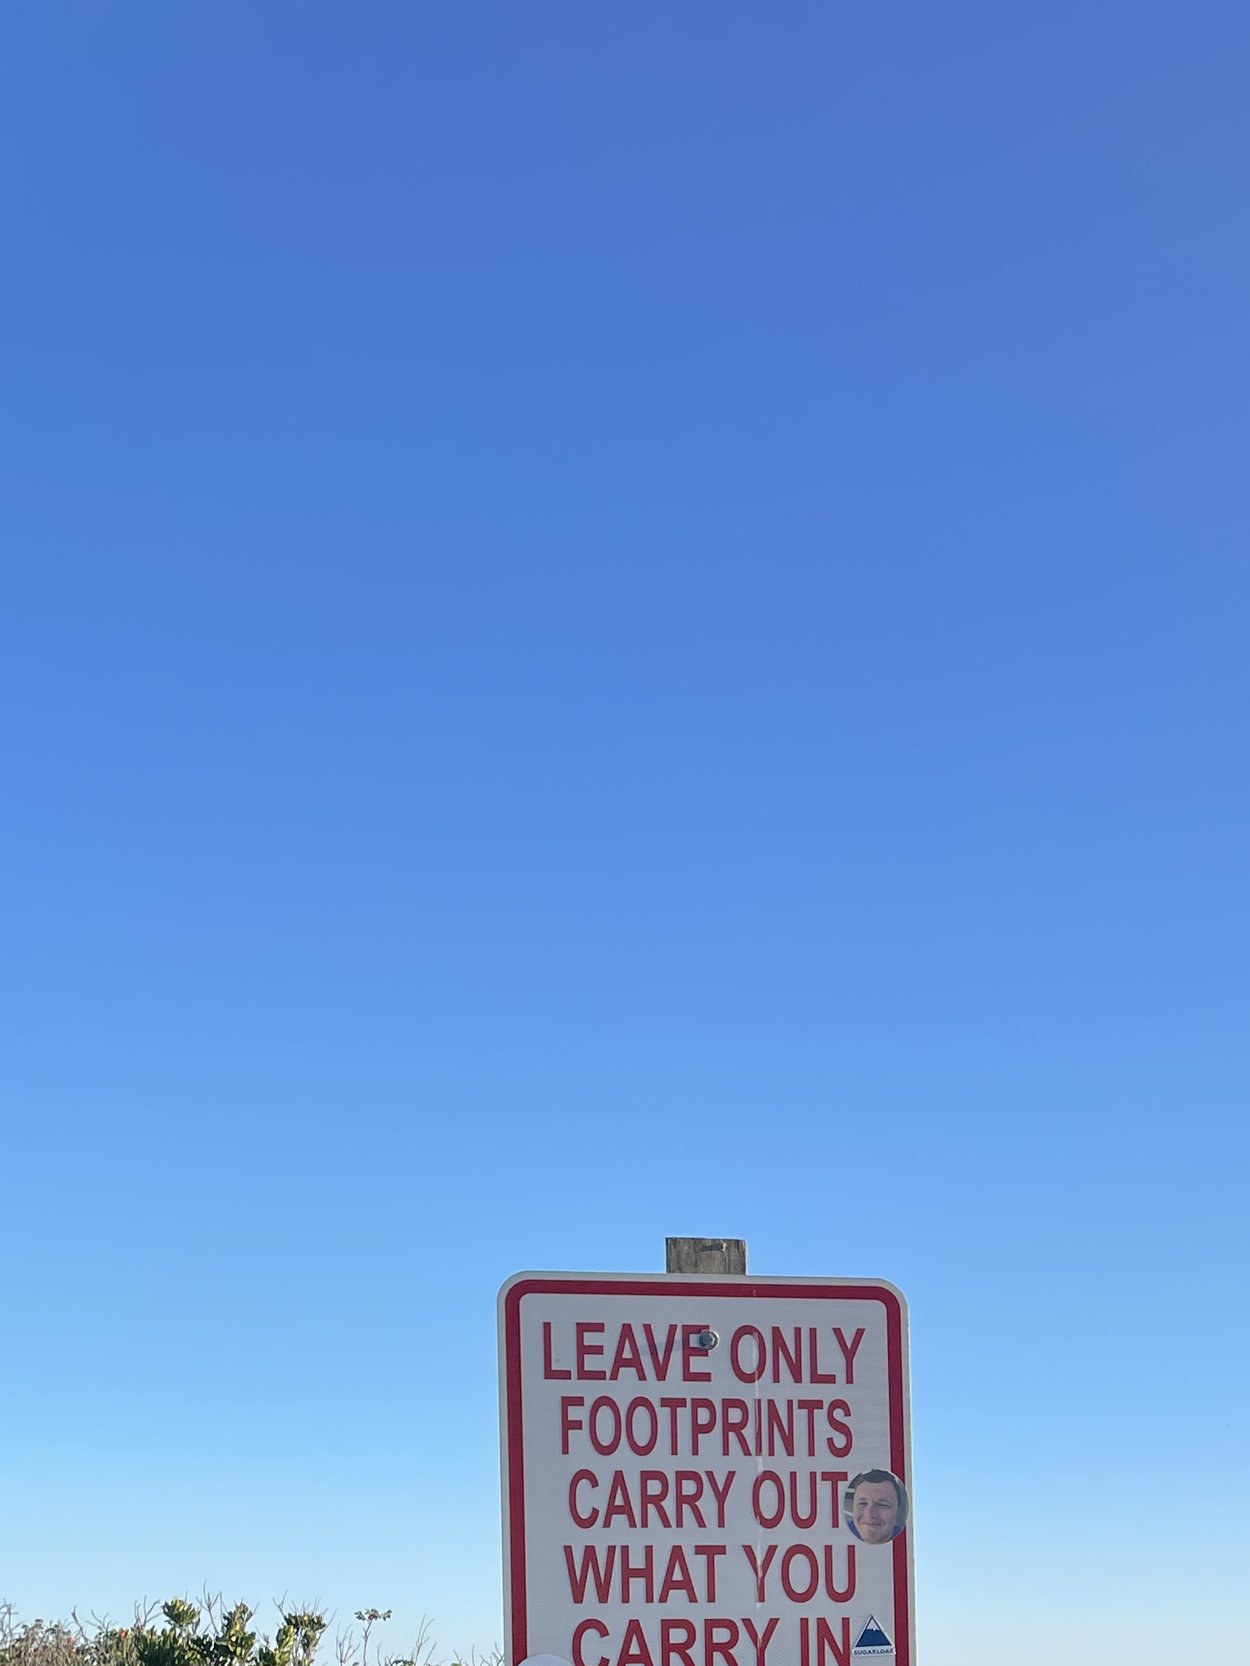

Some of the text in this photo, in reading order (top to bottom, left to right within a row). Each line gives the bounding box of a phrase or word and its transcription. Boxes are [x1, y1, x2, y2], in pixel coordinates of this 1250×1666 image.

[543, 1321, 865, 1385] LEAVE ONLY
[561, 1396, 853, 1458] FOOTPRINTS
[568, 1469, 849, 1530] CARRY OUT
[564, 1542, 857, 1604] WHAT YOU
